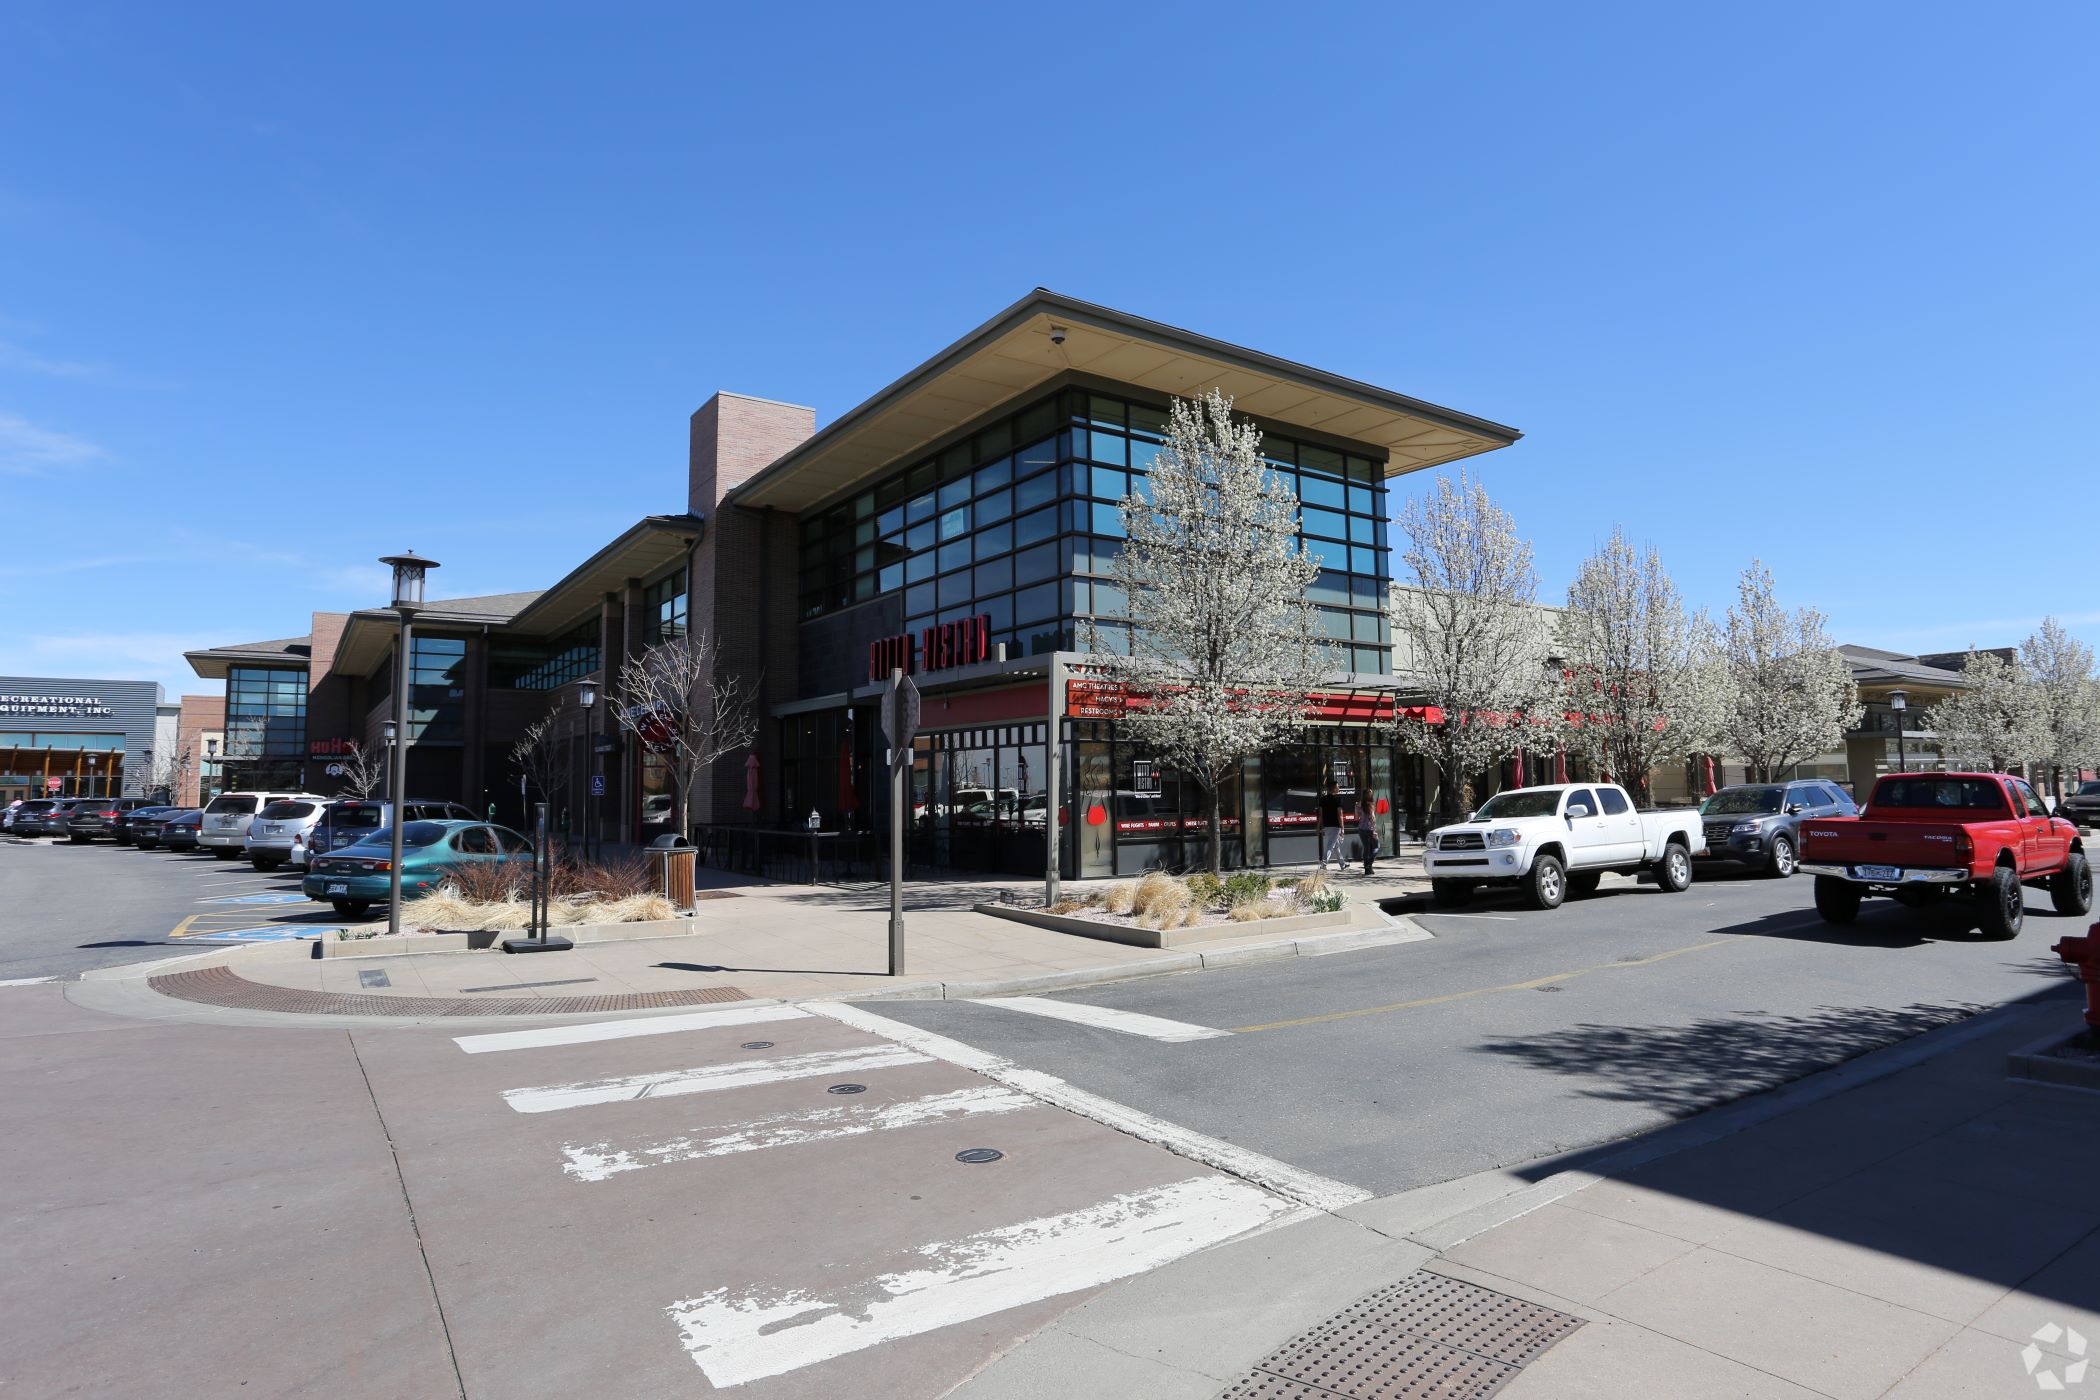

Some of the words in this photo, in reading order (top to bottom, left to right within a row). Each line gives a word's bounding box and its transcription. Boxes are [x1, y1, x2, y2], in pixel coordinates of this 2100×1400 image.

[922, 614, 990, 672] BISTRO
[1088, 683, 1118, 691] THEATRES
[1080, 707, 1118, 715] RESTROOMS
